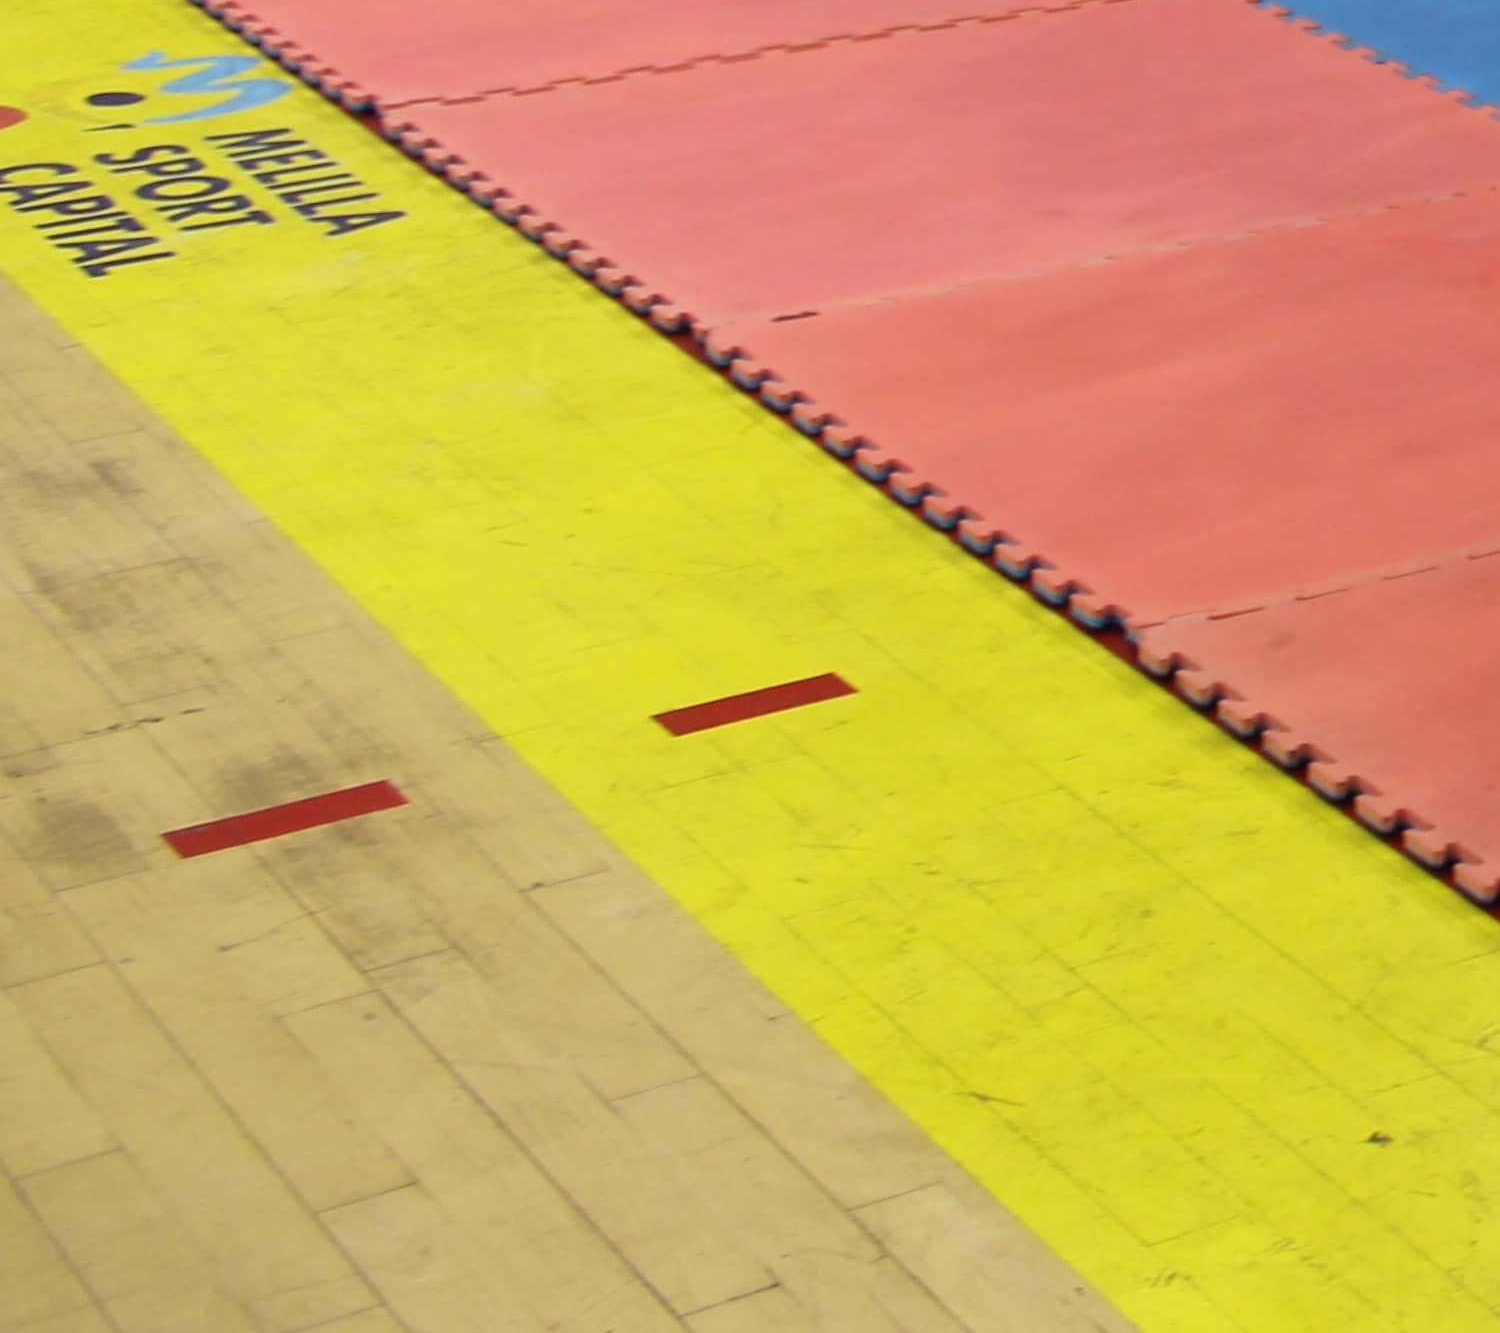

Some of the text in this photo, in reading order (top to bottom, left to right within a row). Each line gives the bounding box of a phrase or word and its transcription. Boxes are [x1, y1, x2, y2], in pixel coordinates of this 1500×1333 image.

[0, 161, 175, 278] CAPITAL
[93, 144, 276, 233] SPORT
[204, 128, 406, 237] MELILLA
